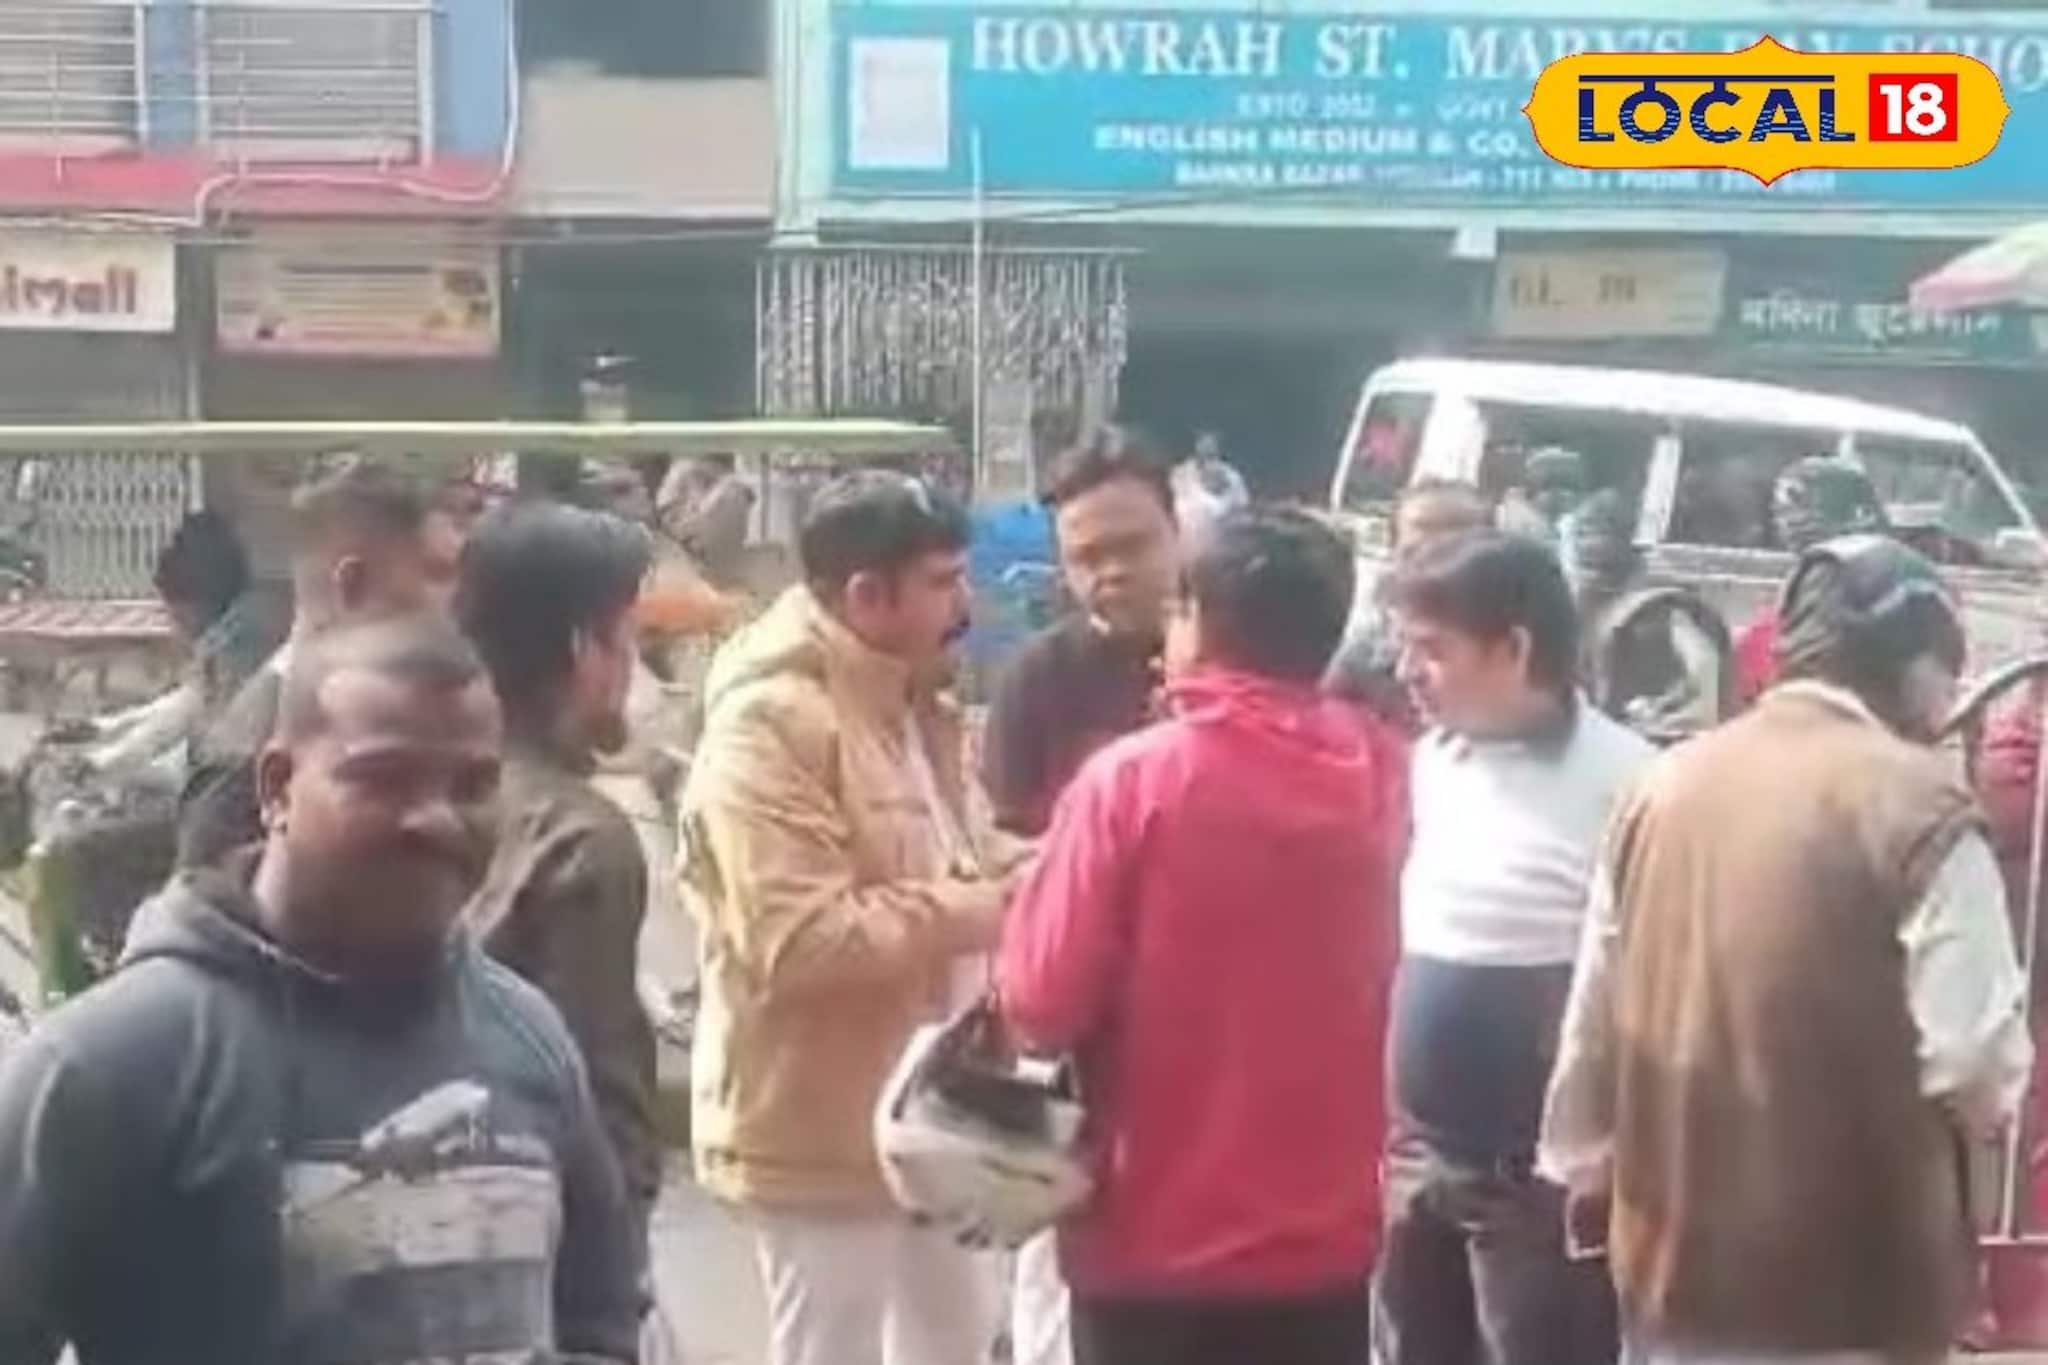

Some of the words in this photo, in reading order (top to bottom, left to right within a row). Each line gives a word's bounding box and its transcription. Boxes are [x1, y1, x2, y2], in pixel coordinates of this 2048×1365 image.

[972, 17, 1281, 75] HOWRAH
[1316, 25, 1410, 80] ST.
[1094, 124, 1259, 151] ENGLISH
[1269, 127, 1420, 154] MEDIUM
[1427, 131, 1453, 155] &
